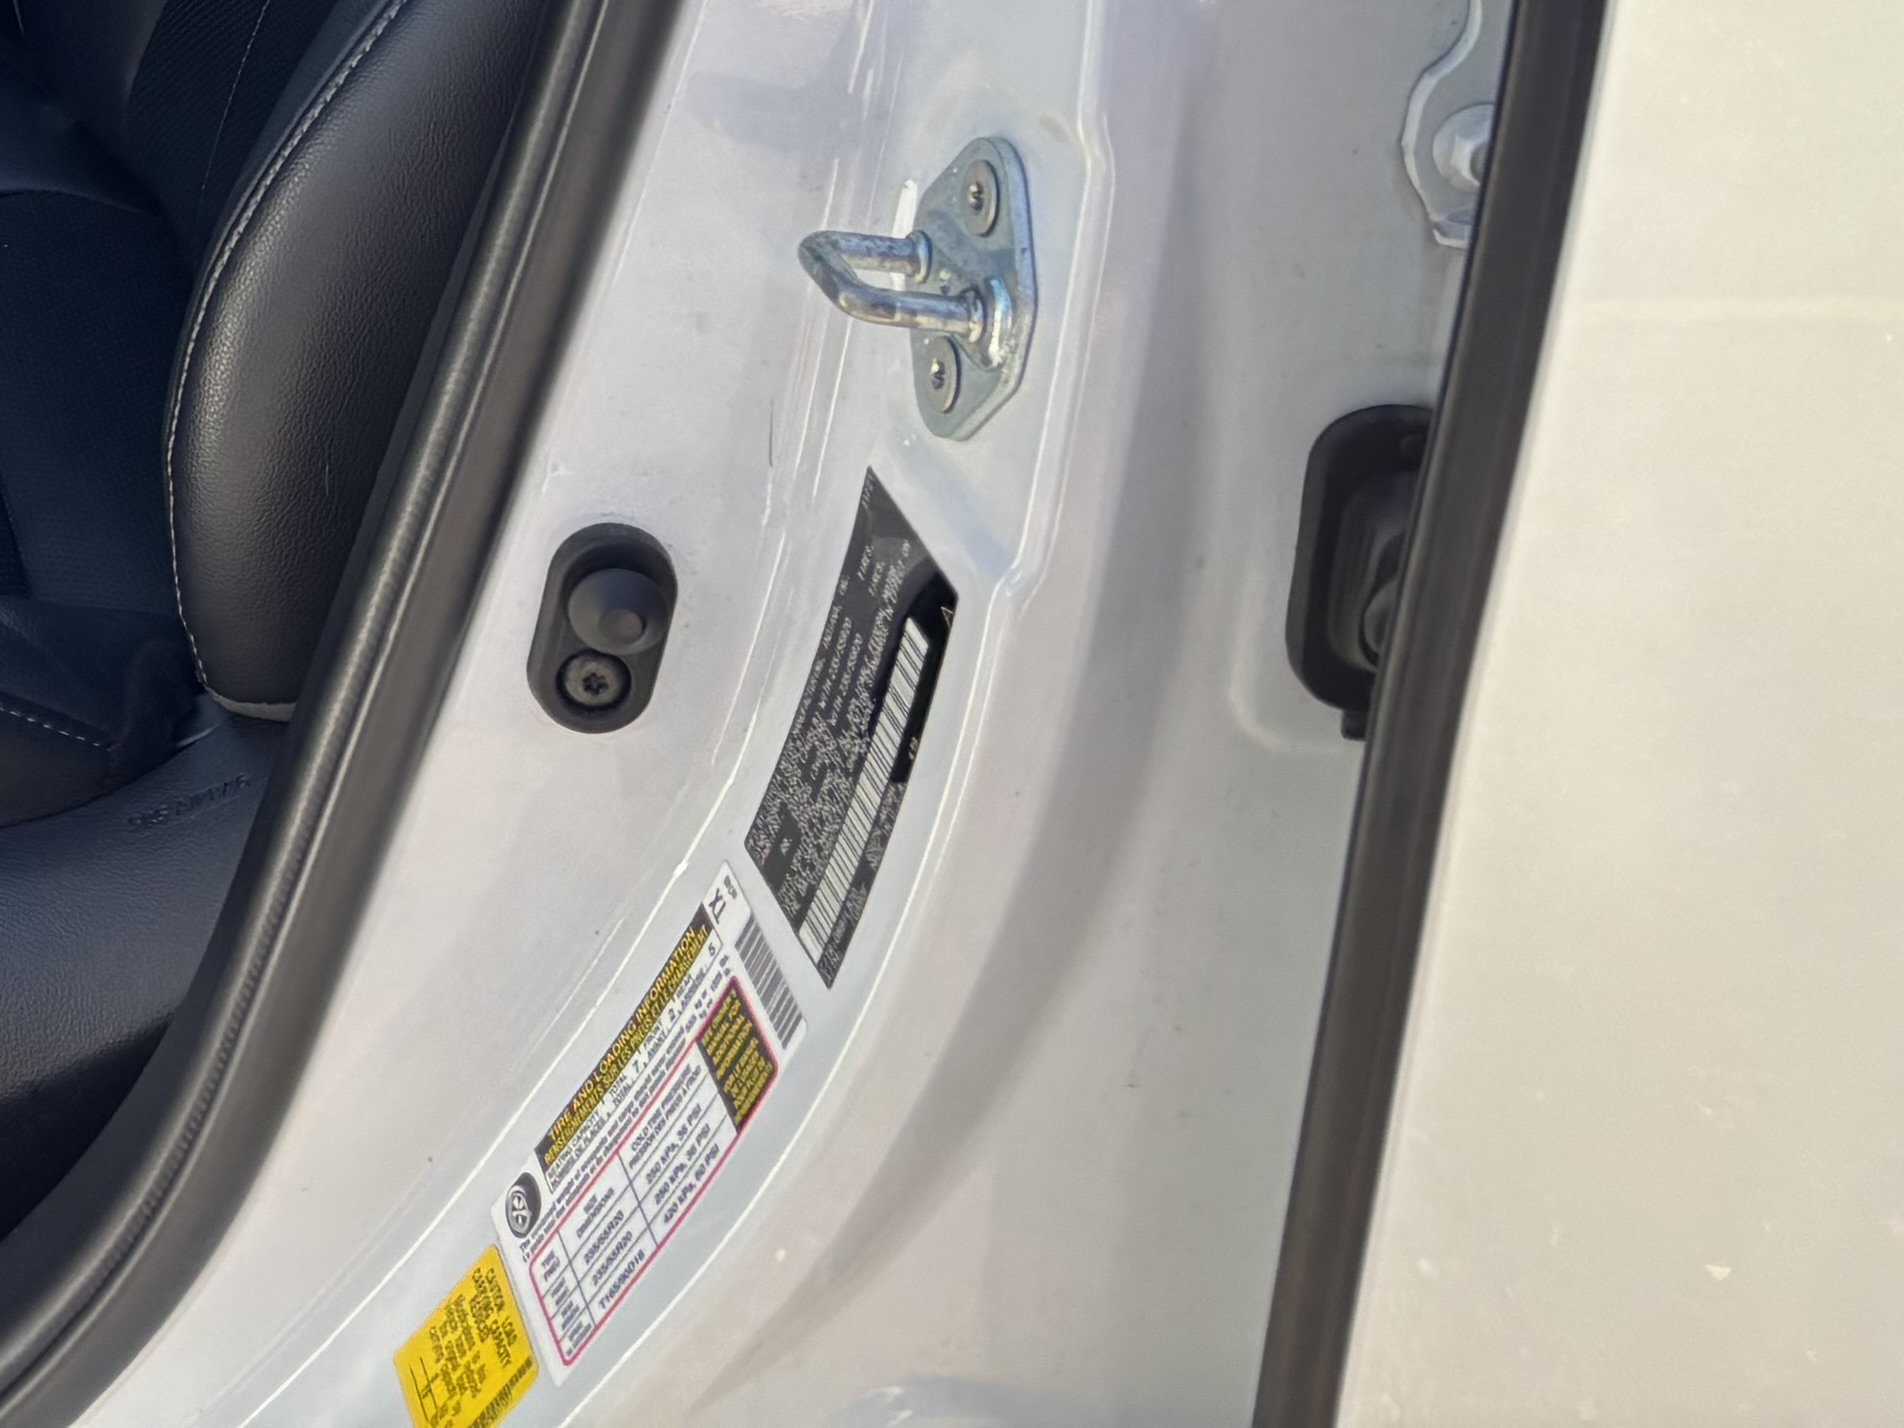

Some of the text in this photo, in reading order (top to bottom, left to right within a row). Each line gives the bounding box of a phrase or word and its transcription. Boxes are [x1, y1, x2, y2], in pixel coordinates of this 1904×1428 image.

[548, 1105, 571, 1144] TIRE
[572, 1076, 594, 1111] AND
[593, 1017, 636, 1084] LOADING
[633, 925, 697, 1023] INFORMATION
